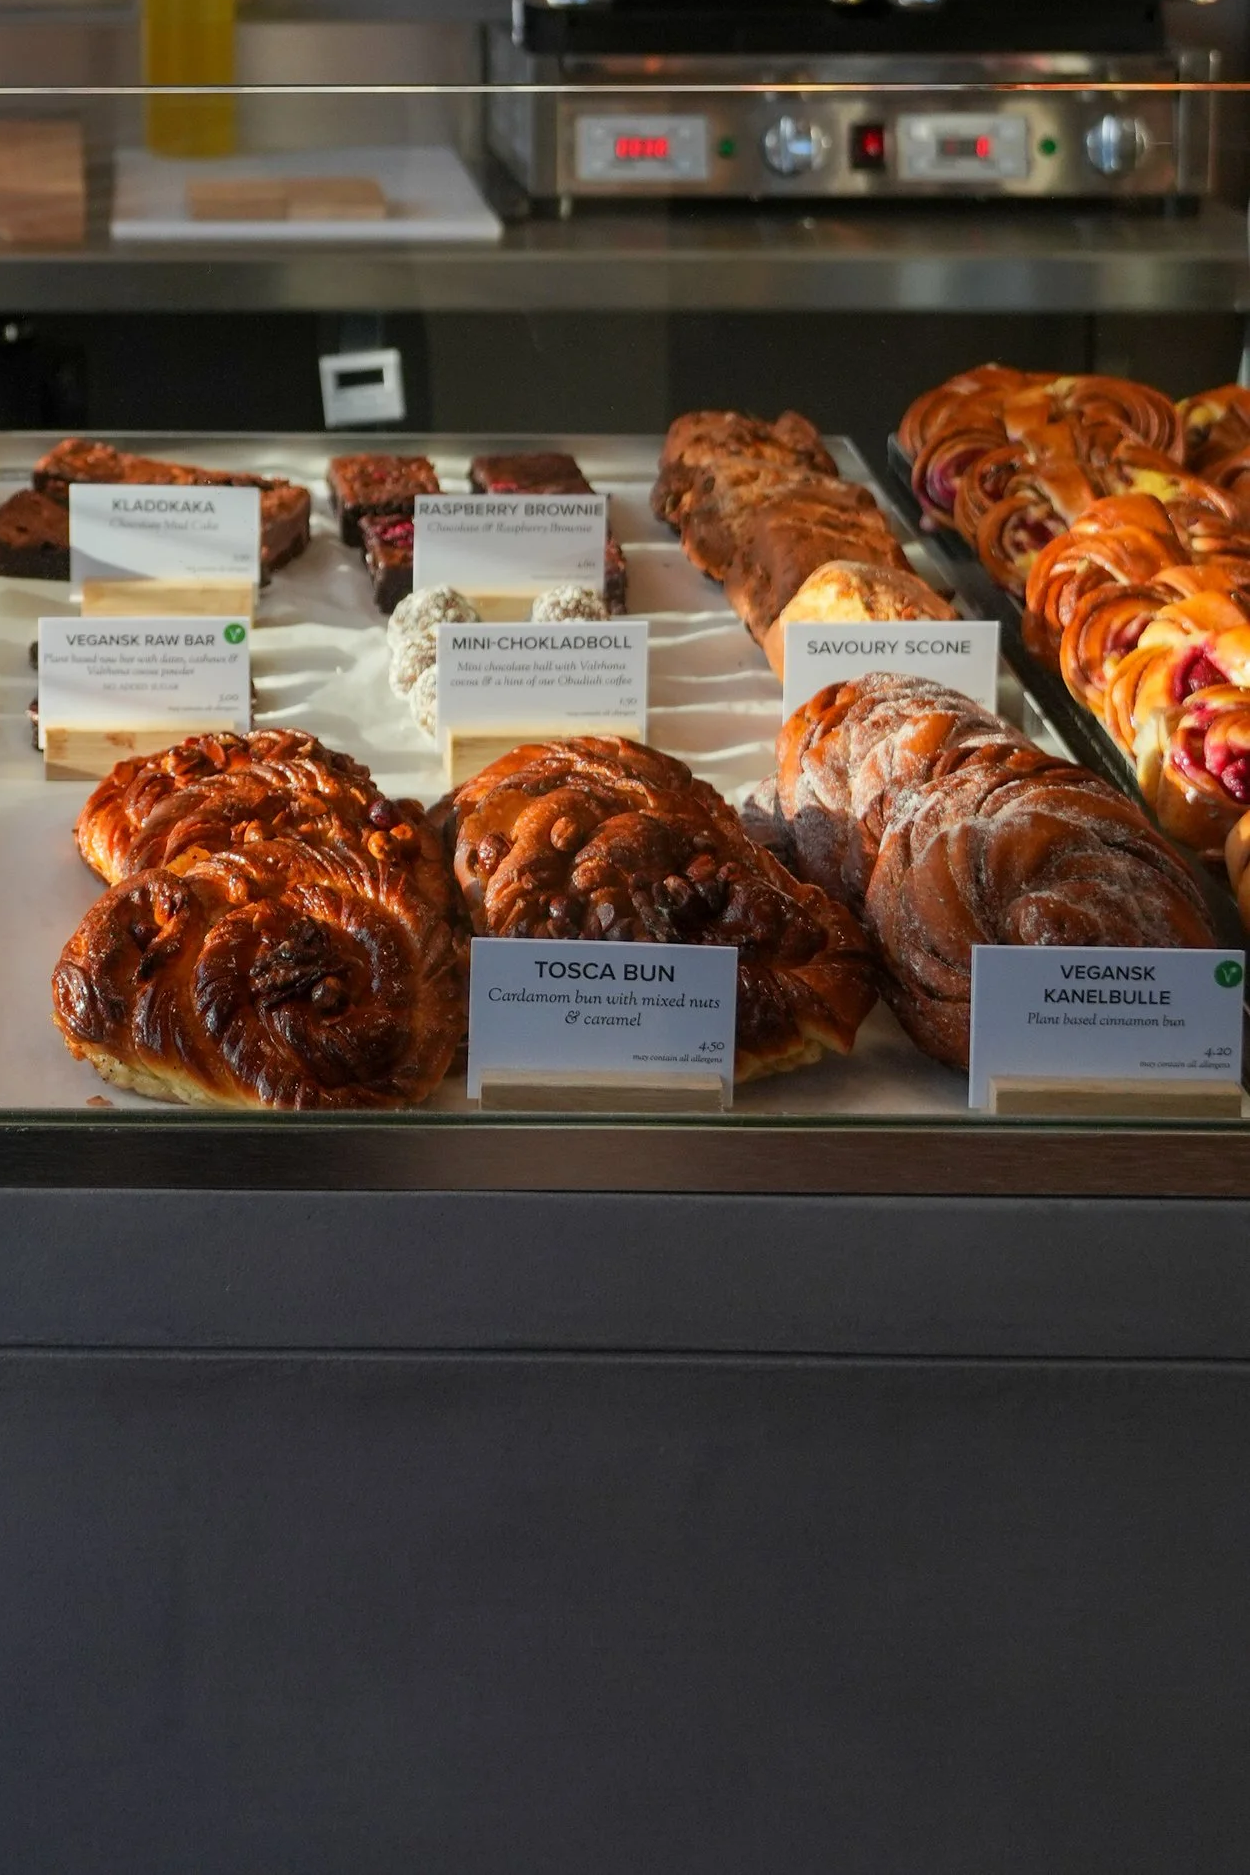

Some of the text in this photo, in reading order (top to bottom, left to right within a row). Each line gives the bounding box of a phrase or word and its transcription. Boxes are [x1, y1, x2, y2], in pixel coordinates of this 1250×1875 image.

[418, 502, 604, 517] RASPBERRY BROWNIE
[66, 633, 215, 646] VEGANSK RAW BAR
[451, 635, 632, 651] MINI-CHOKLADBOLL
[807, 639, 971, 655] SAVOURY SCONE
[457, 660, 627, 672] Mini chocolate ball with Valrhona
[450, 679, 478, 687] cocoa
[504, 676, 523, 686] hint
[526, 675, 536, 688] of
[557, 675, 602, 686] Obadiah
[604, 675, 633, 687] coffee
[534, 960, 676, 983] TOSCA BUN
[1059, 964, 1156, 981] VEGANSK
[487, 986, 721, 1010] Cardamom bun with mixed nuts
[1043, 988, 1172, 1006] KANELBULLE
[564, 1010, 642, 1027] & caramel
[1027, 1011, 1186, 1027] Plant based cinnamon bun
[698, 1040, 726, 1052] 4.50
[1204, 1047, 1232, 1058] 4.20
[632, 1053, 723, 1065] may contain all allergens
